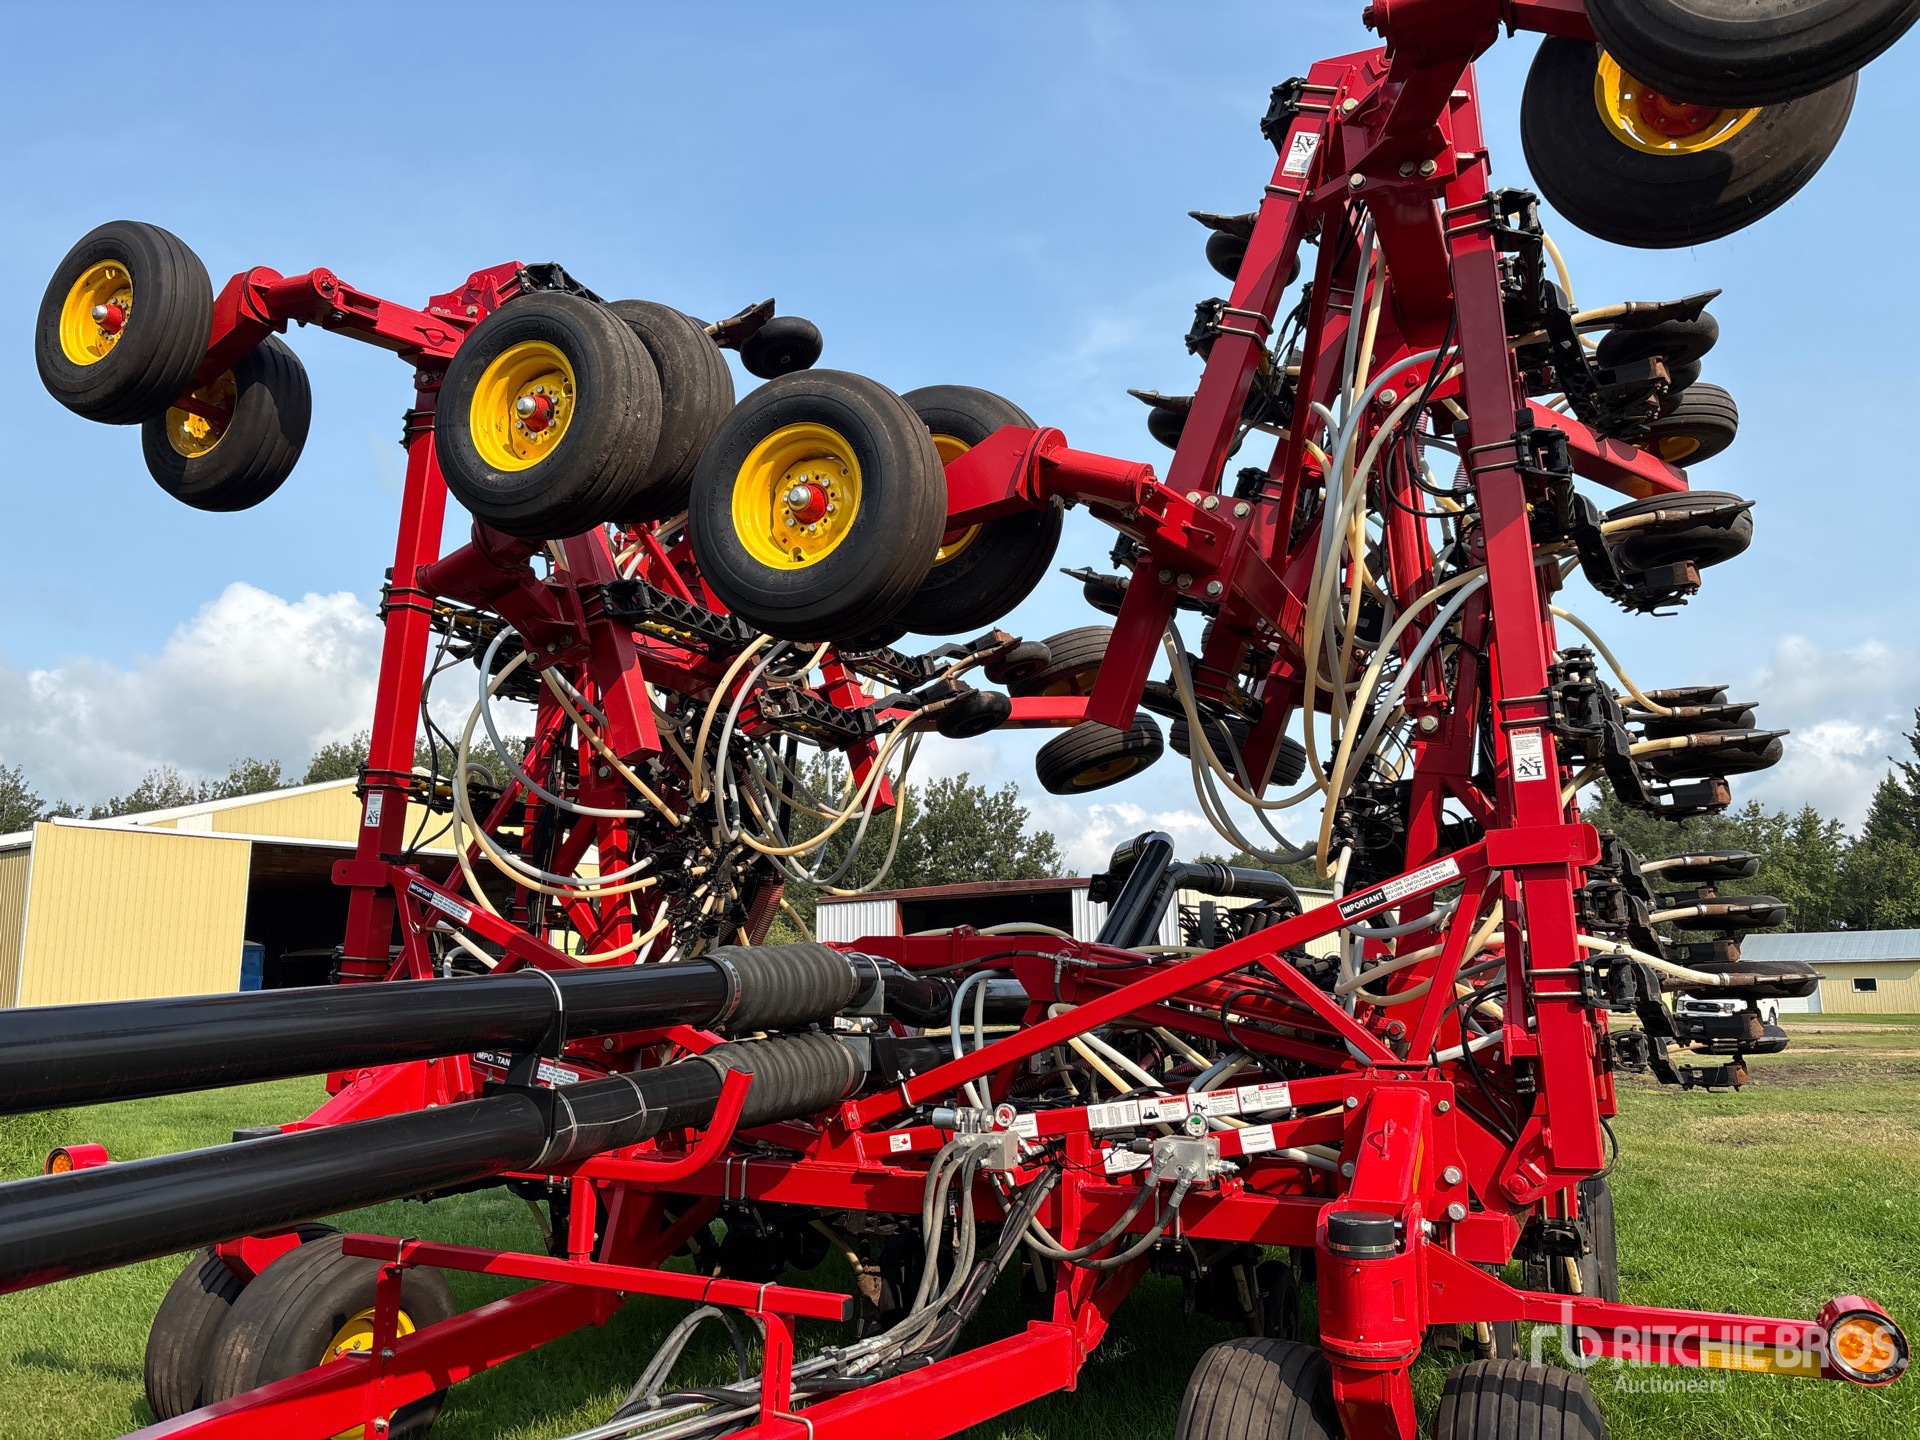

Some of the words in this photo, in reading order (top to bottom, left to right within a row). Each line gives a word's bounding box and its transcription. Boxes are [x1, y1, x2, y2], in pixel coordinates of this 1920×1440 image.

[1382, 881, 1402, 891] FAILURE
[1409, 869, 1430, 880] UNLOCK
[1430, 862, 1447, 872] WINGS
[1385, 885, 1404, 896] BEFORE
[1404, 874, 1432, 888] UNFOLDING
[1432, 869, 1444, 877] WILL
[1386, 891, 1403, 901] CAUSE
[1403, 879, 1435, 893] STRUCTURAL
[1434, 869, 1456, 880] DAMAGE
[1341, 892, 1383, 914] IMPORTANT
[476, 1051, 511, 1066] IMPOTAN
